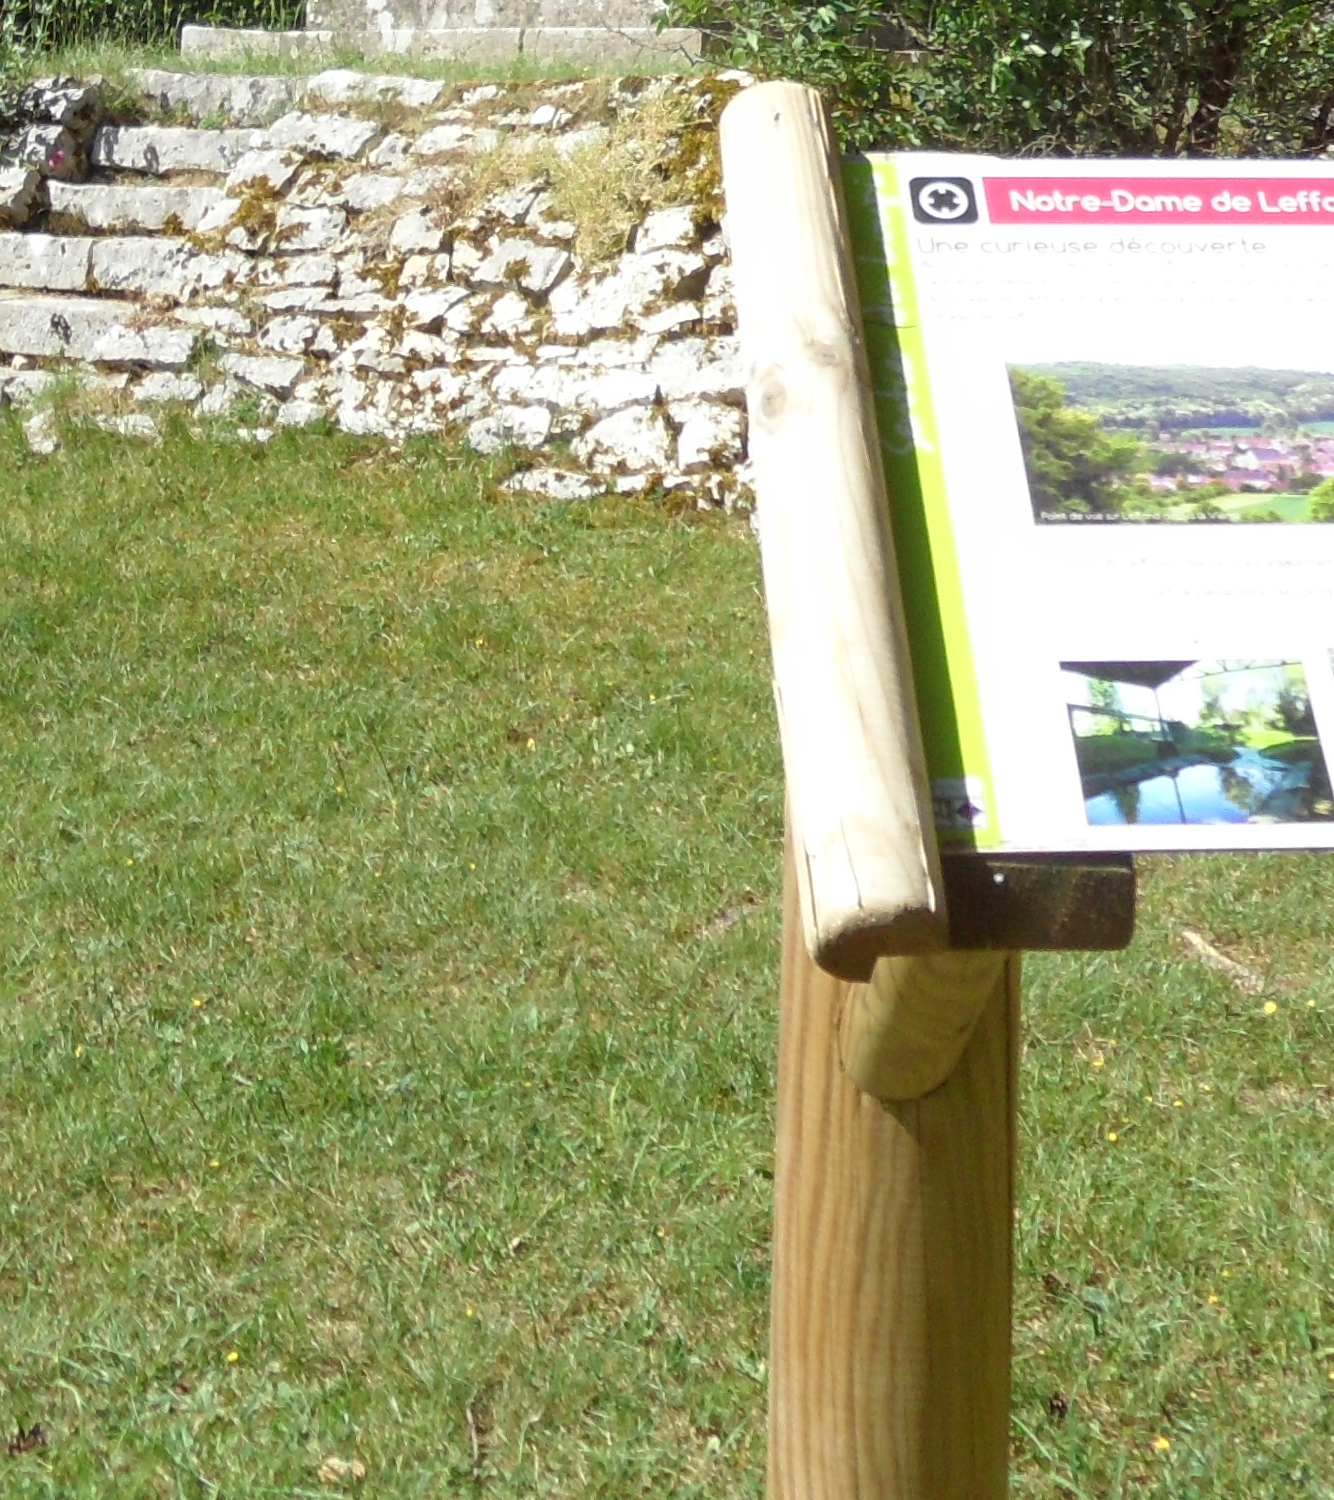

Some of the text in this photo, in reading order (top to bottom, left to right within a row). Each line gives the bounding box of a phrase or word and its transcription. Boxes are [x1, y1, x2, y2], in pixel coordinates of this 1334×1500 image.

[1008, 188, 1203, 213] Notre-Dame
[1211, 189, 1252, 213] de
[916, 236, 1267, 255] Une curieuse découverte
